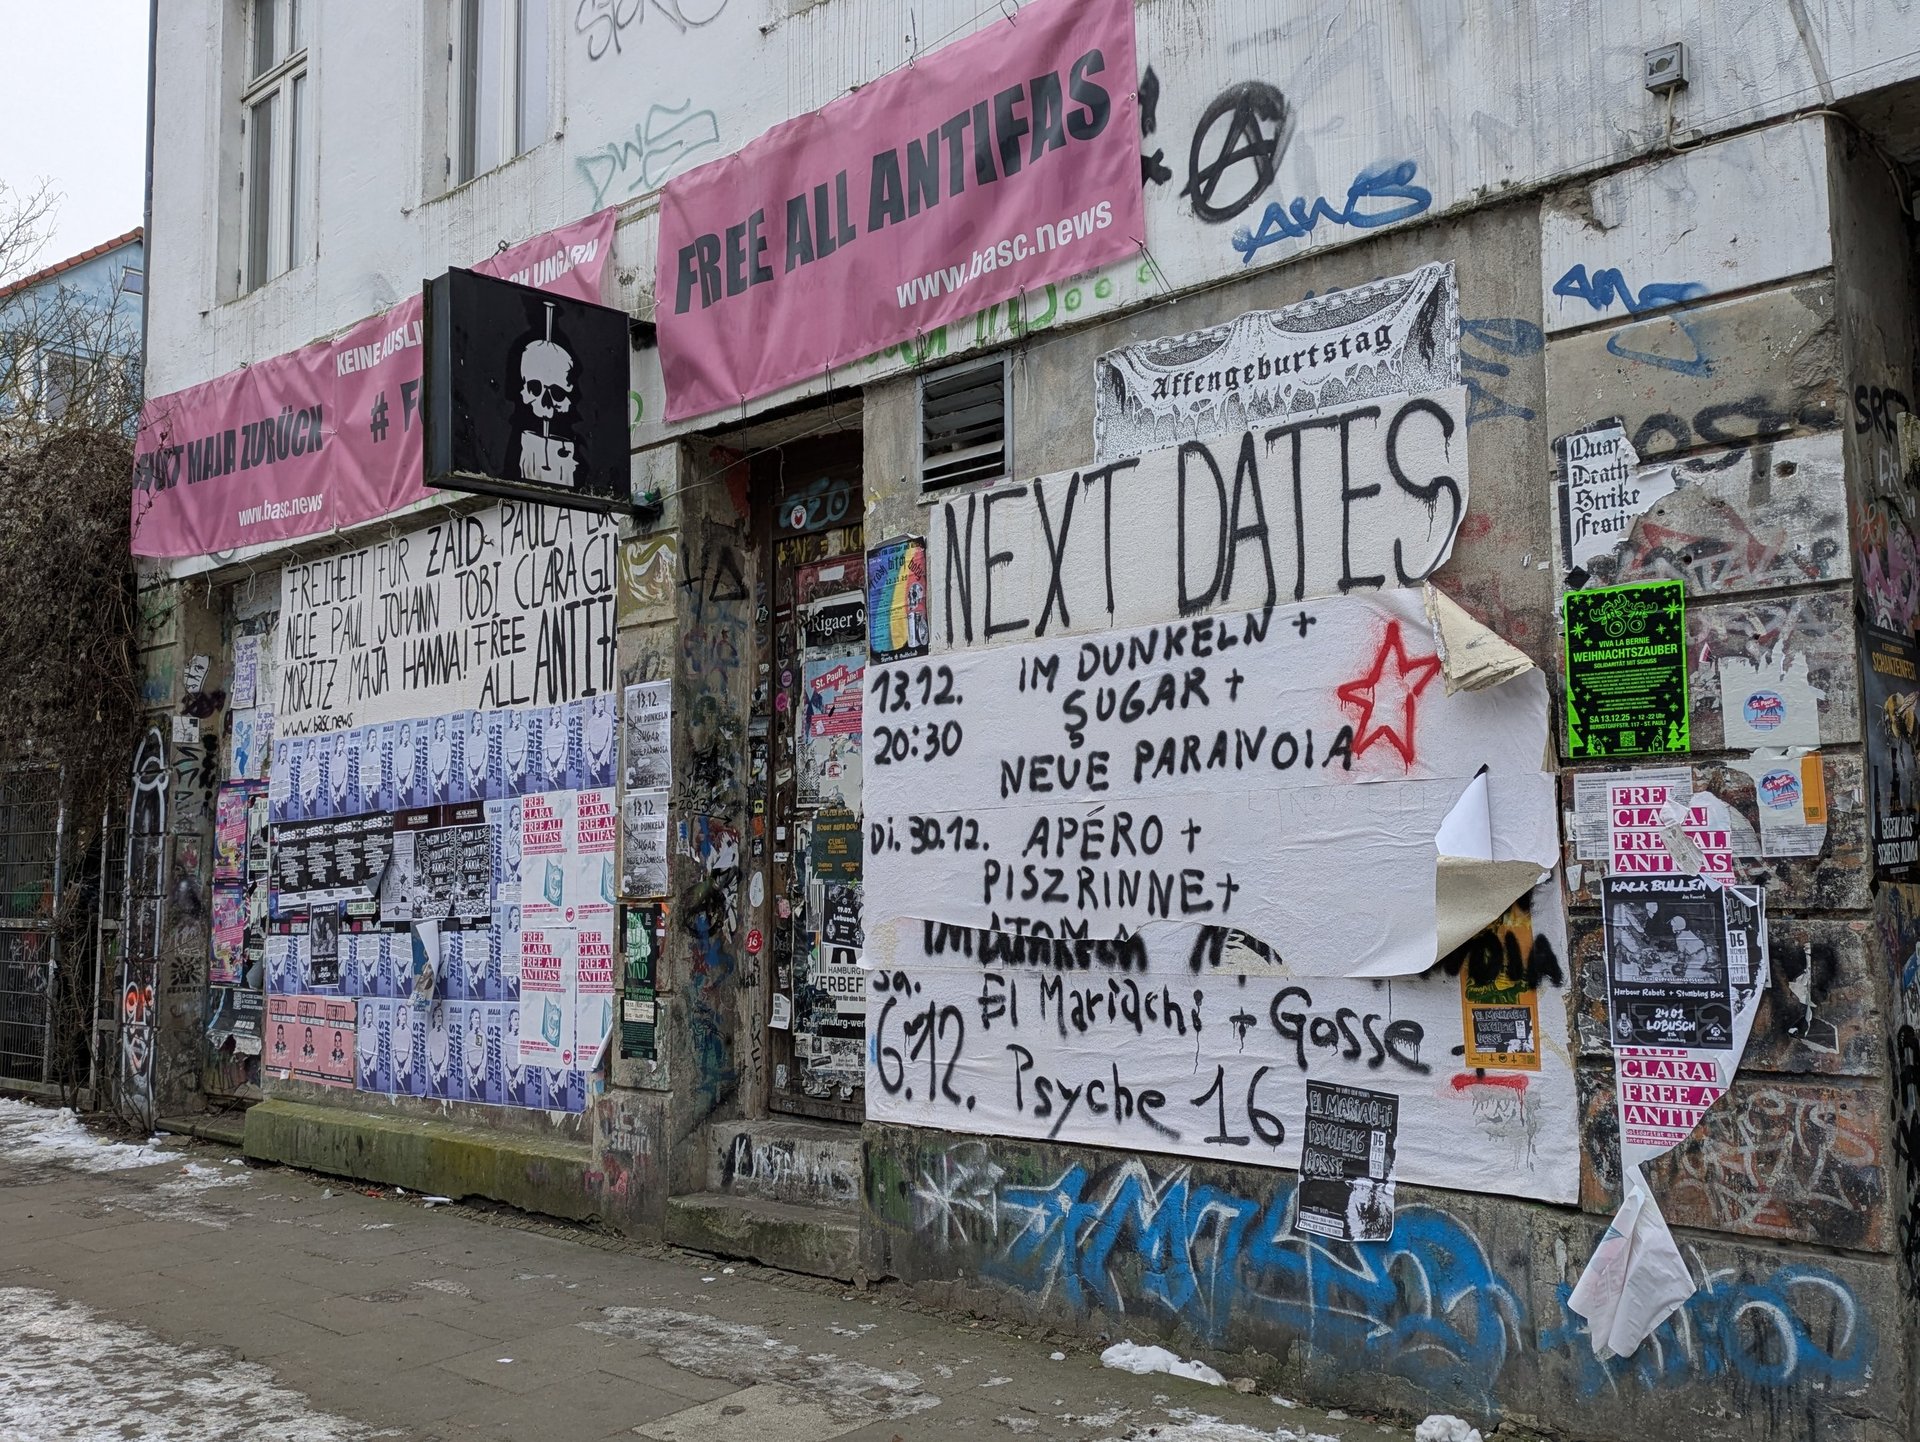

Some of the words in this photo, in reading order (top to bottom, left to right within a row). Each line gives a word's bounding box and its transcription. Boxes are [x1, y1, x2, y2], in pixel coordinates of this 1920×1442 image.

[674, 208, 774, 315] FREE
[785, 169, 856, 275] ALL
[867, 48, 1111, 233] ANTIFAS
[896, 200, 1112, 309] www.basc.news
[336, 346, 381, 377] KEINE
[534, 239, 599, 287] UNGARN
[1151, 323, 1394, 400] Affengeburtstag
[187, 429, 236, 484] MAJA
[240, 403, 323, 470] ZURÜCK
[1572, 462, 1630, 489] Death
[238, 493, 323, 526] www.basc.news
[1573, 487, 1641, 514] Strike
[944, 457, 1140, 648] NEXT
[1176, 398, 1462, 620] DATES
[288, 550, 368, 613] FREIHEIT
[285, 611, 317, 660] NELE
[331, 600, 367, 655] PAUL
[378, 580, 441, 645] JOHANN
[455, 562, 501, 623] TOBI
[514, 541, 578, 610] CLARA
[812, 614, 853, 637] Rigaer
[1573, 643, 1678, 663] WEIHNACHTSZAUBER
[1599, 640, 1613, 648] VIVA
[1615, 639, 1625, 647] LA
[1625, 636, 1650, 646] BERNIE
[281, 658, 338, 715] MORITZ
[348, 646, 389, 705] MAJA
[403, 628, 468, 690] HANNA!
[471, 616, 527, 666] FREE
[871, 664, 963, 714] 13.12.
[1019, 653, 1059, 695] IM
[1077, 605, 1275, 682] DUNKELN
[1292, 611, 1318, 639] +
[479, 660, 530, 709] ALL
[815, 677, 826, 689] St.
[826, 667, 843, 684] Pauli
[1224, 667, 1245, 701] +
[636, 690, 660, 709] 13.12.
[282, 712, 353, 738] www.basc.news
[1589, 715, 1600, 723] SA
[1600, 714, 1631, 723] 13.12.25
[873, 719, 963, 766] 20:30
[1000, 751, 1110, 798] NEUE
[1132, 722, 1354, 782] PARANOIA
[523, 796, 544, 808] FREE
[578, 792, 601, 804] FREE
[633, 798, 656, 817] 13.12.
[578, 804, 610, 818] CLARA!
[1614, 808, 1708, 828] CLAA!
[523, 820, 542, 833] FREE
[578, 818, 601, 831] FREE
[871, 815, 901, 856] Di.
[909, 815, 990, 856] 30.12.
[1022, 804, 1164, 861] APÉRO
[1180, 817, 1202, 854] +
[1881, 817, 1900, 840] GEGEN
[1901, 815, 1914, 838] DAS
[522, 932, 544, 942] FREE
[522, 944, 552, 954] CLARA!
[578, 932, 601, 943] FREE
[578, 944, 611, 955] CLARA!
[522, 957, 542, 968] FREE
[578, 958, 601, 969] FREE
[1614, 988, 1640, 996] Harbour
[1676, 989, 1709, 999] Stumbling
[979, 972, 1018, 1029] El
[1040, 973, 1205, 1038] Mariachi
[1269, 986, 1432, 1074] Gosse
[1646, 1020, 1696, 1032] LOBUSCH
[1622, 1060, 1716, 1082] CLARA!
[1006, 1042, 1182, 1140] Psyche
[1190, 1064, 1286, 1148] 16
[1309, 1090, 1323, 1115] EL
[1623, 1083, 1691, 1105] FREE
[1304, 1148, 1345, 1180] GOSSE
